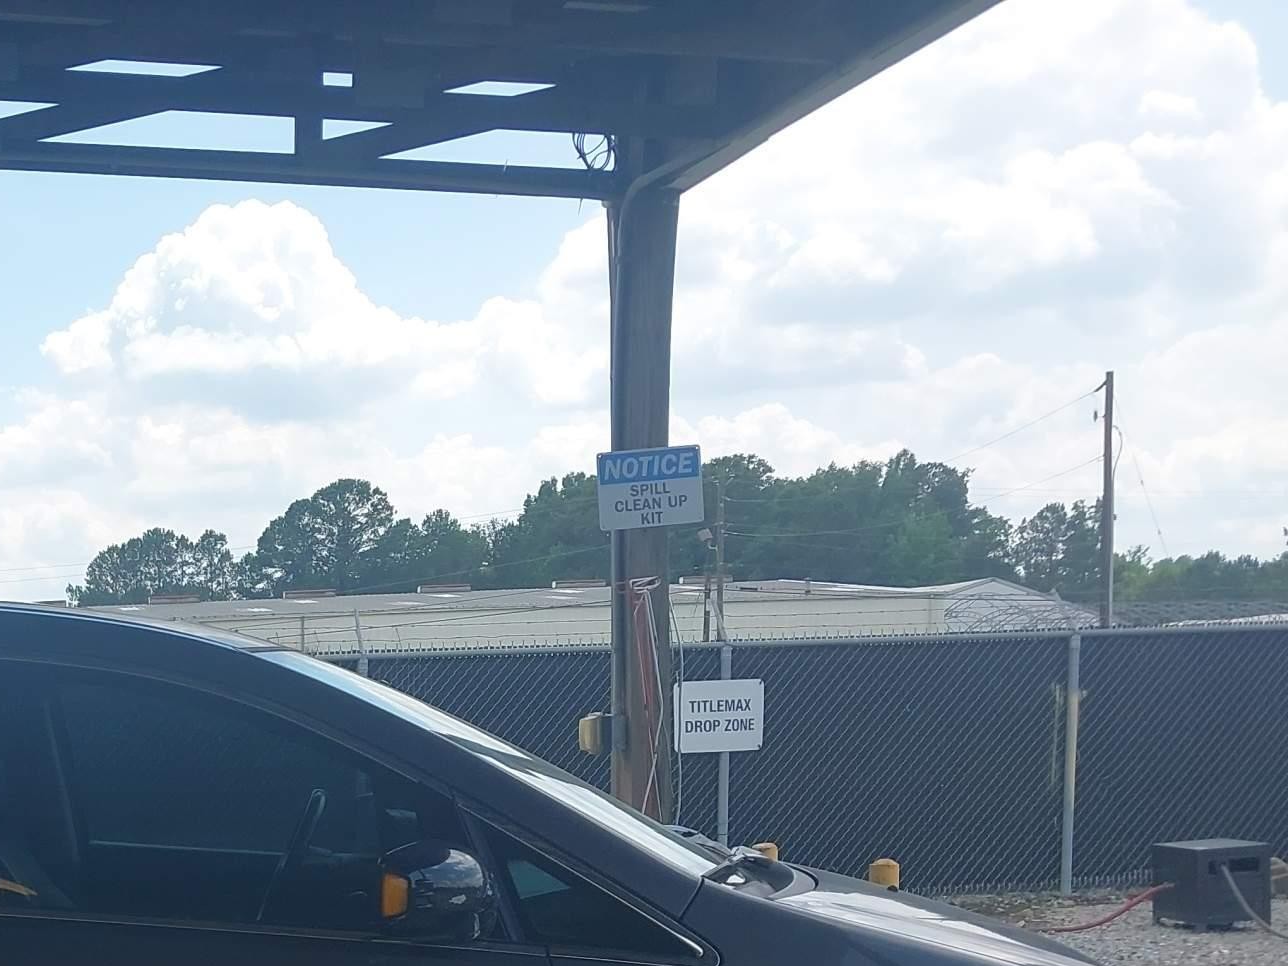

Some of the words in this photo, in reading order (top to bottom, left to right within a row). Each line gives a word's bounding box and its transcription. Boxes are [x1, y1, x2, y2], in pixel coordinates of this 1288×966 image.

[604, 453, 694, 480] NOTICE
[630, 482, 671, 497] SPILL
[614, 497, 662, 513] CLEAN
[667, 495, 688, 508] UP
[640, 511, 664, 525] KIT
[688, 698, 752, 713] TITLEMAX
[685, 719, 721, 734] DROP
[724, 718, 755, 732] ZONE
